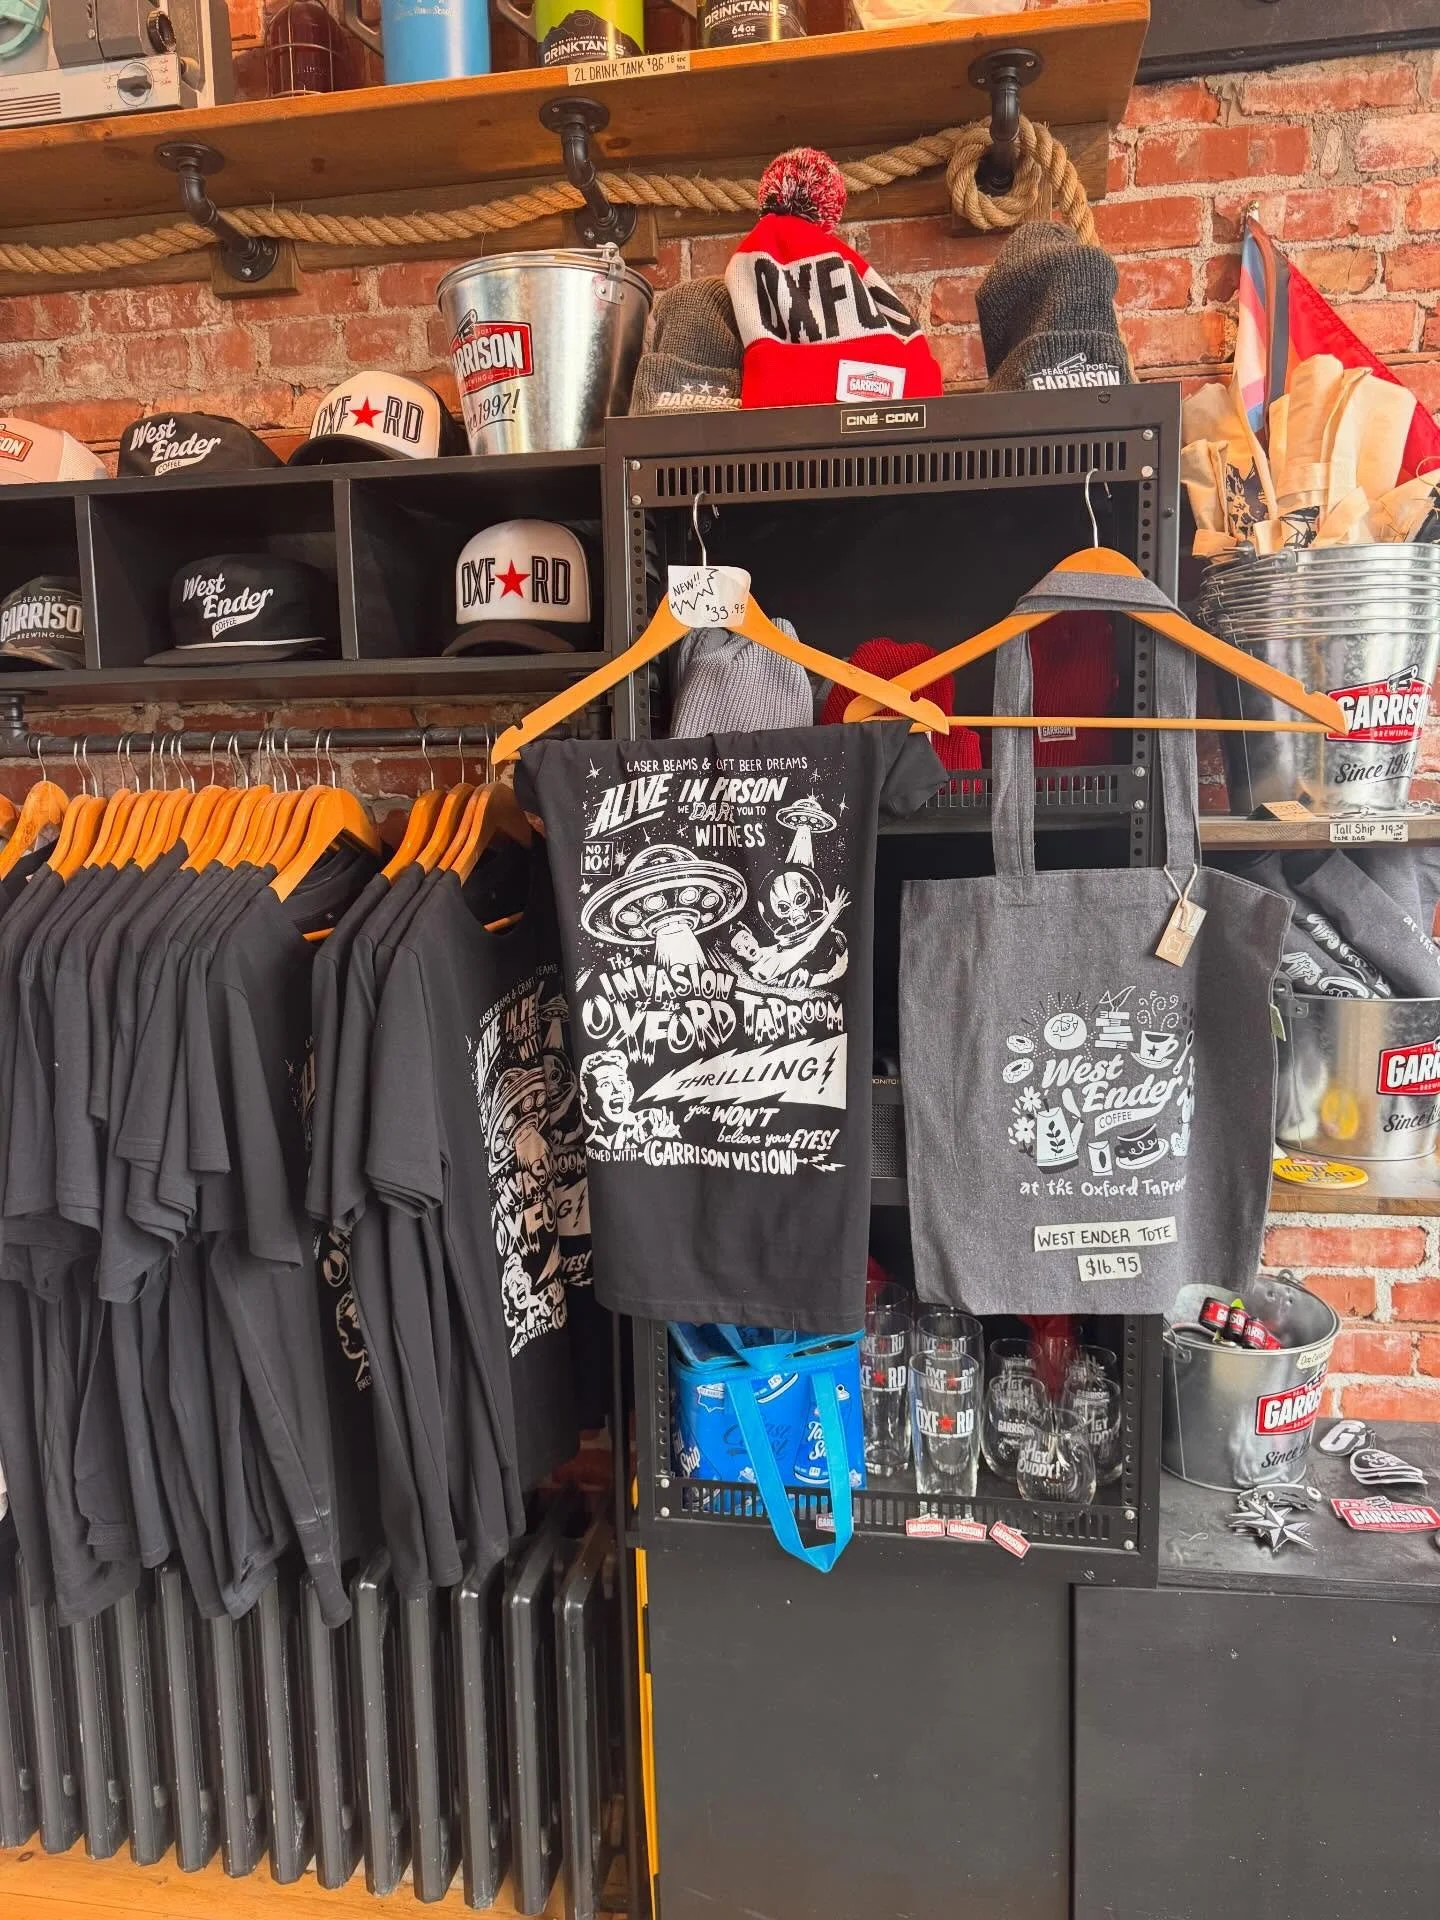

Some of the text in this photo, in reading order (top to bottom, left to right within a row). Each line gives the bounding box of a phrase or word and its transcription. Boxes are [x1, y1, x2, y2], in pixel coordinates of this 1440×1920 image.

[704, 0, 788, 28] DRINKTANS
[543, 40, 625, 64] DRINKTANS
[574, 67, 587, 82] 2L
[589, 61, 619, 80] DRINK
[620, 59, 645, 77] TANK
[1086, 362, 1109, 372] PORT
[848, 378, 891, 397] GARRISON
[1032, 369, 1121, 391] GARRISON
[130, 417, 177, 451] West
[150, 432, 222, 462] Ender
[157, 460, 182, 474] COFFEE
[182, 572, 226, 603] West
[203, 586, 274, 619] Ender
[0, 601, 83, 642] GARRISO
[214, 617, 237, 632] COFFEE
[626, 759, 660, 773] LASER
[662, 757, 699, 773] BEAMS
[701, 757, 712, 770] &
[739, 758, 762, 772] BEER
[766, 756, 808, 771] DREAMS
[1334, 762, 1383, 784] Since
[584, 772, 789, 840] ALIVE IN PRSON
[677, 804, 690, 814] WE
[755, 805, 767, 816] TO
[695, 822, 766, 848] WITNESS
[1354, 823, 1376, 836] Ship
[606, 952, 633, 971] The
[598, 964, 735, 1003] INVASION
[634, 999, 681, 1011] of the
[581, 990, 844, 1068] OXFORD TAPROOM
[1040, 1053, 1125, 1089] West
[1081, 1073, 1183, 1113] Ender
[684, 1104, 780, 1128] you WON'T
[1099, 1110, 1133, 1129] COFFEE
[716, 1126, 840, 1151] believe your EYES!
[612, 1149, 637, 1162] WITH
[1019, 1181, 1041, 1197] at
[1080, 1176, 1139, 1197] Oxford
[1036, 1224, 1172, 1248] WEST ENDER TOTE
[1085, 1256, 1139, 1277] $16.95
[1348, 1508, 1437, 1525] GARRISON
